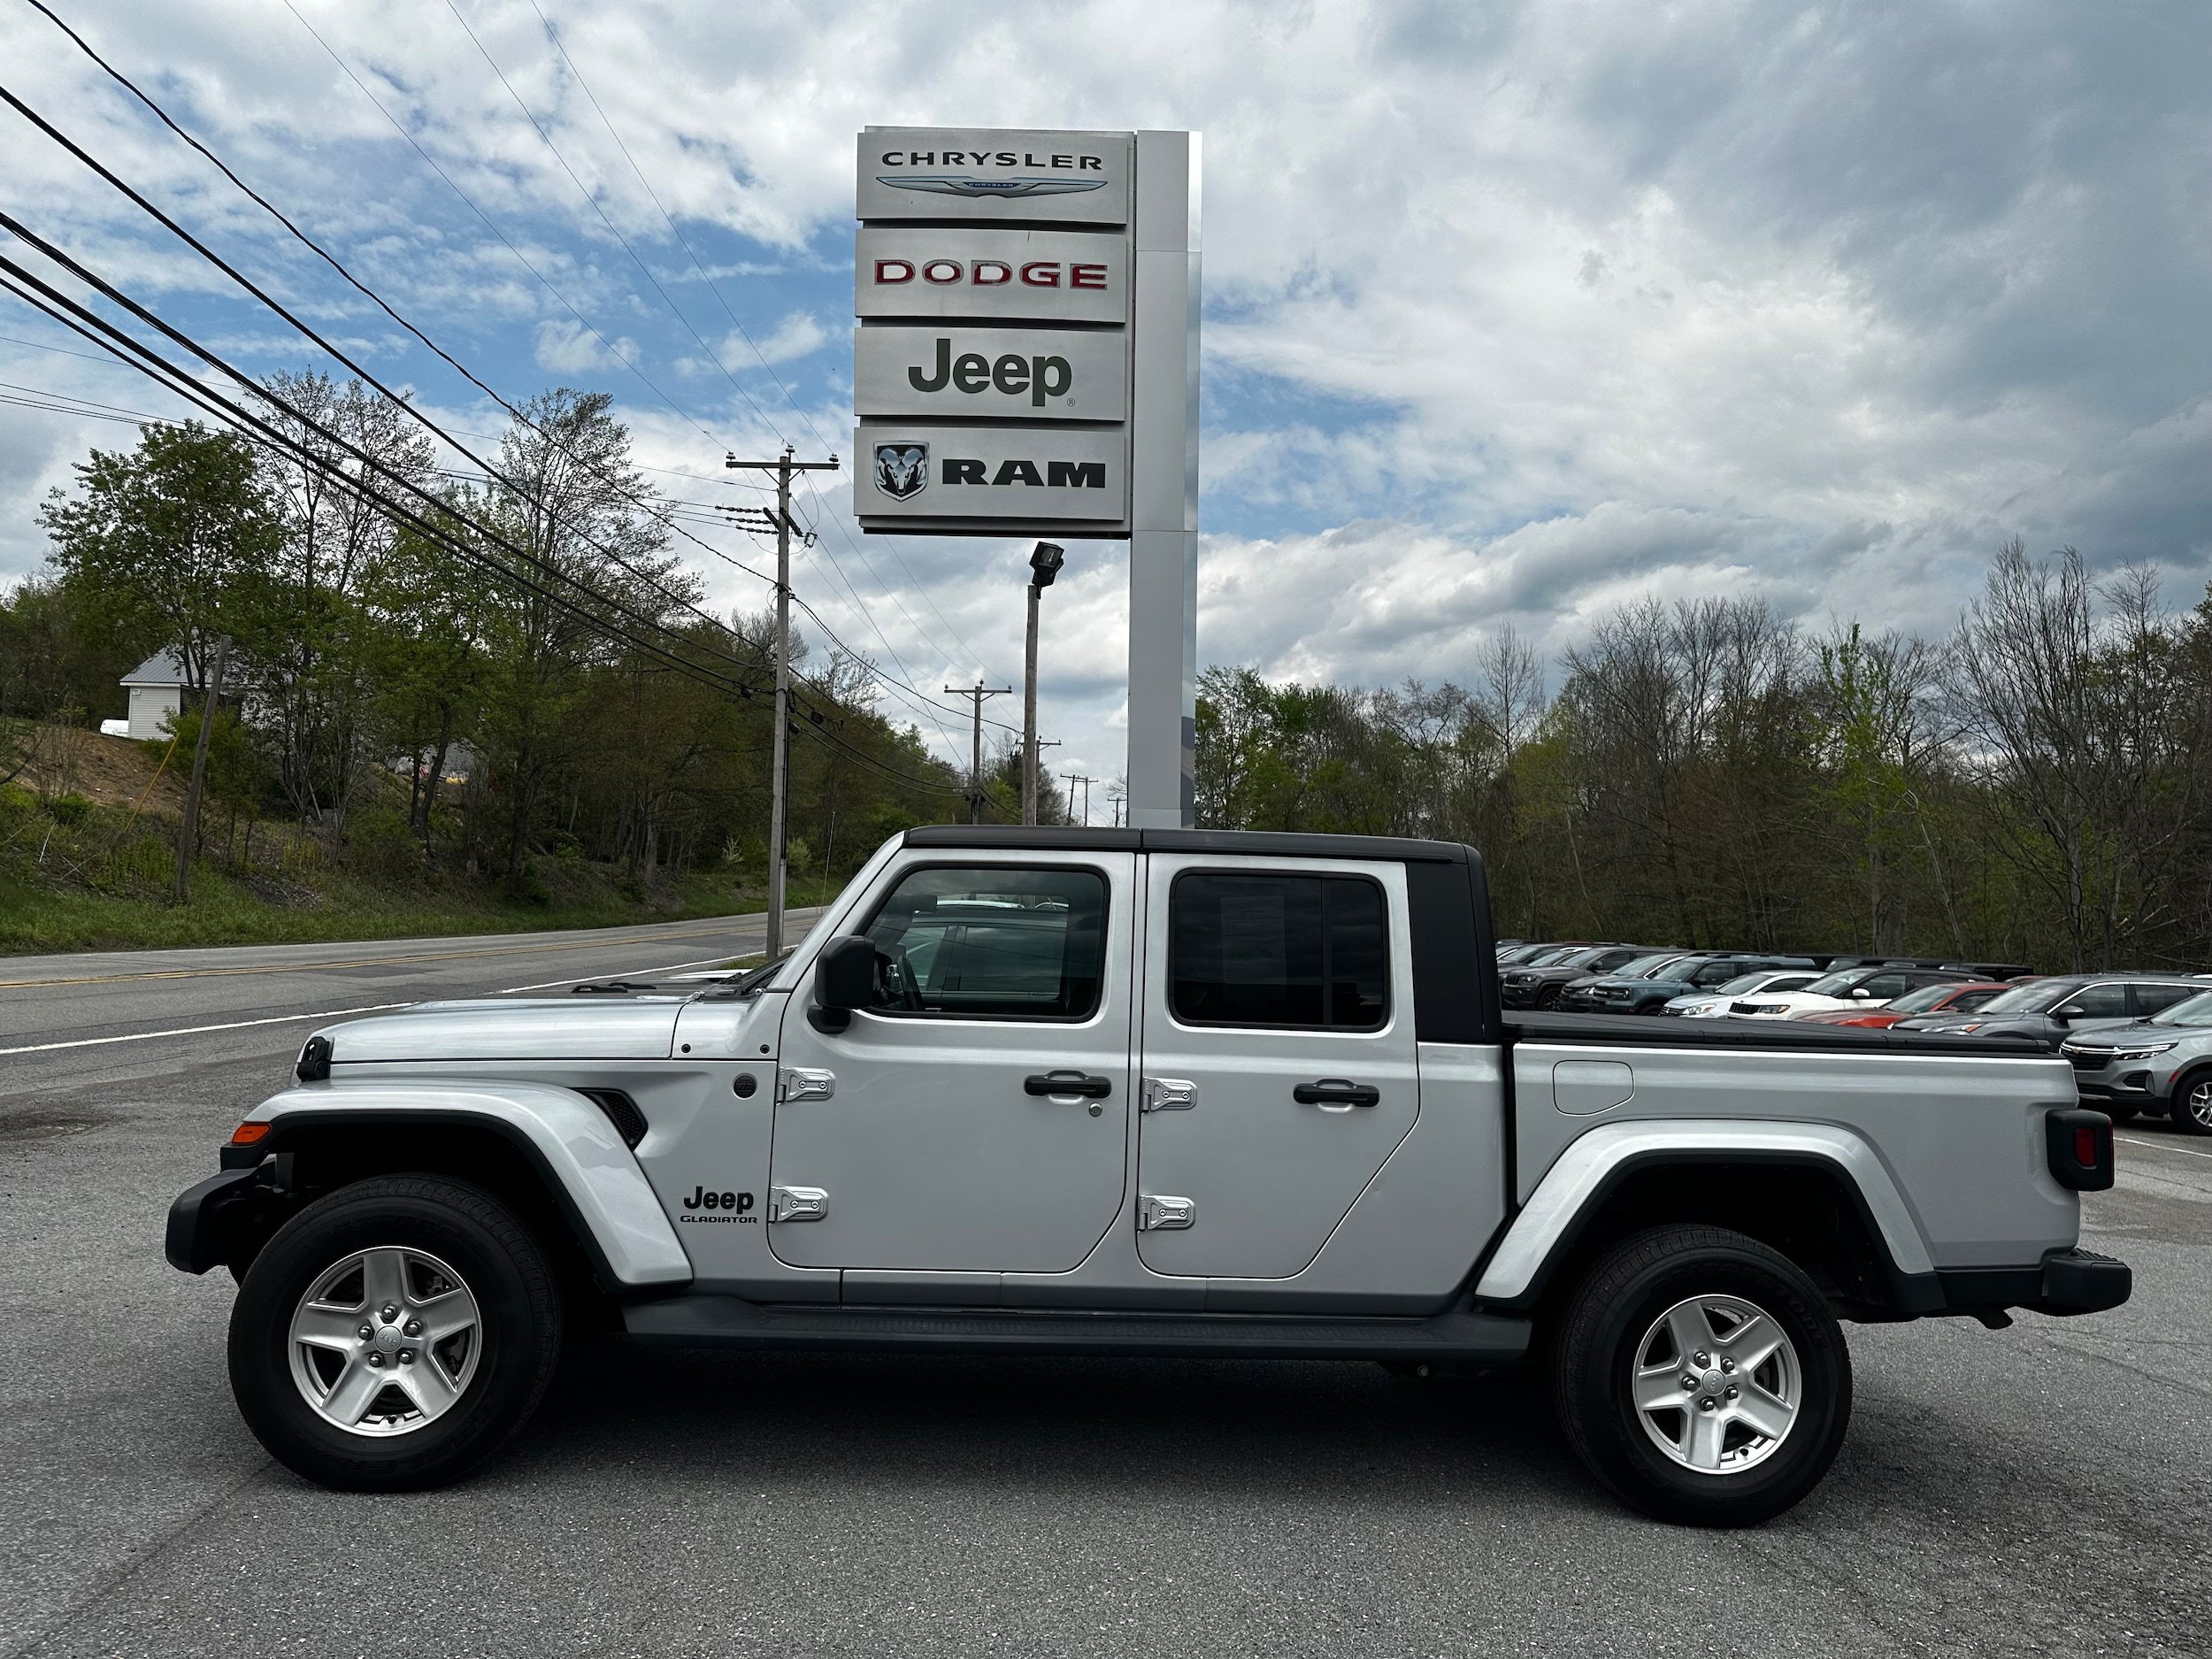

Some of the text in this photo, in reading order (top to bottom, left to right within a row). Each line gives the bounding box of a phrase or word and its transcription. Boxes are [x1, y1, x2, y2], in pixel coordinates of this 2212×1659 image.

[881, 151, 1103, 171] CHRYSLER
[874, 259, 1109, 291] DODGE
[908, 338, 1072, 407] Jeep
[942, 458, 1106, 488] RAM
[683, 1186, 754, 1215] Jeep
[680, 1215, 758, 1224] GLADIATOR
